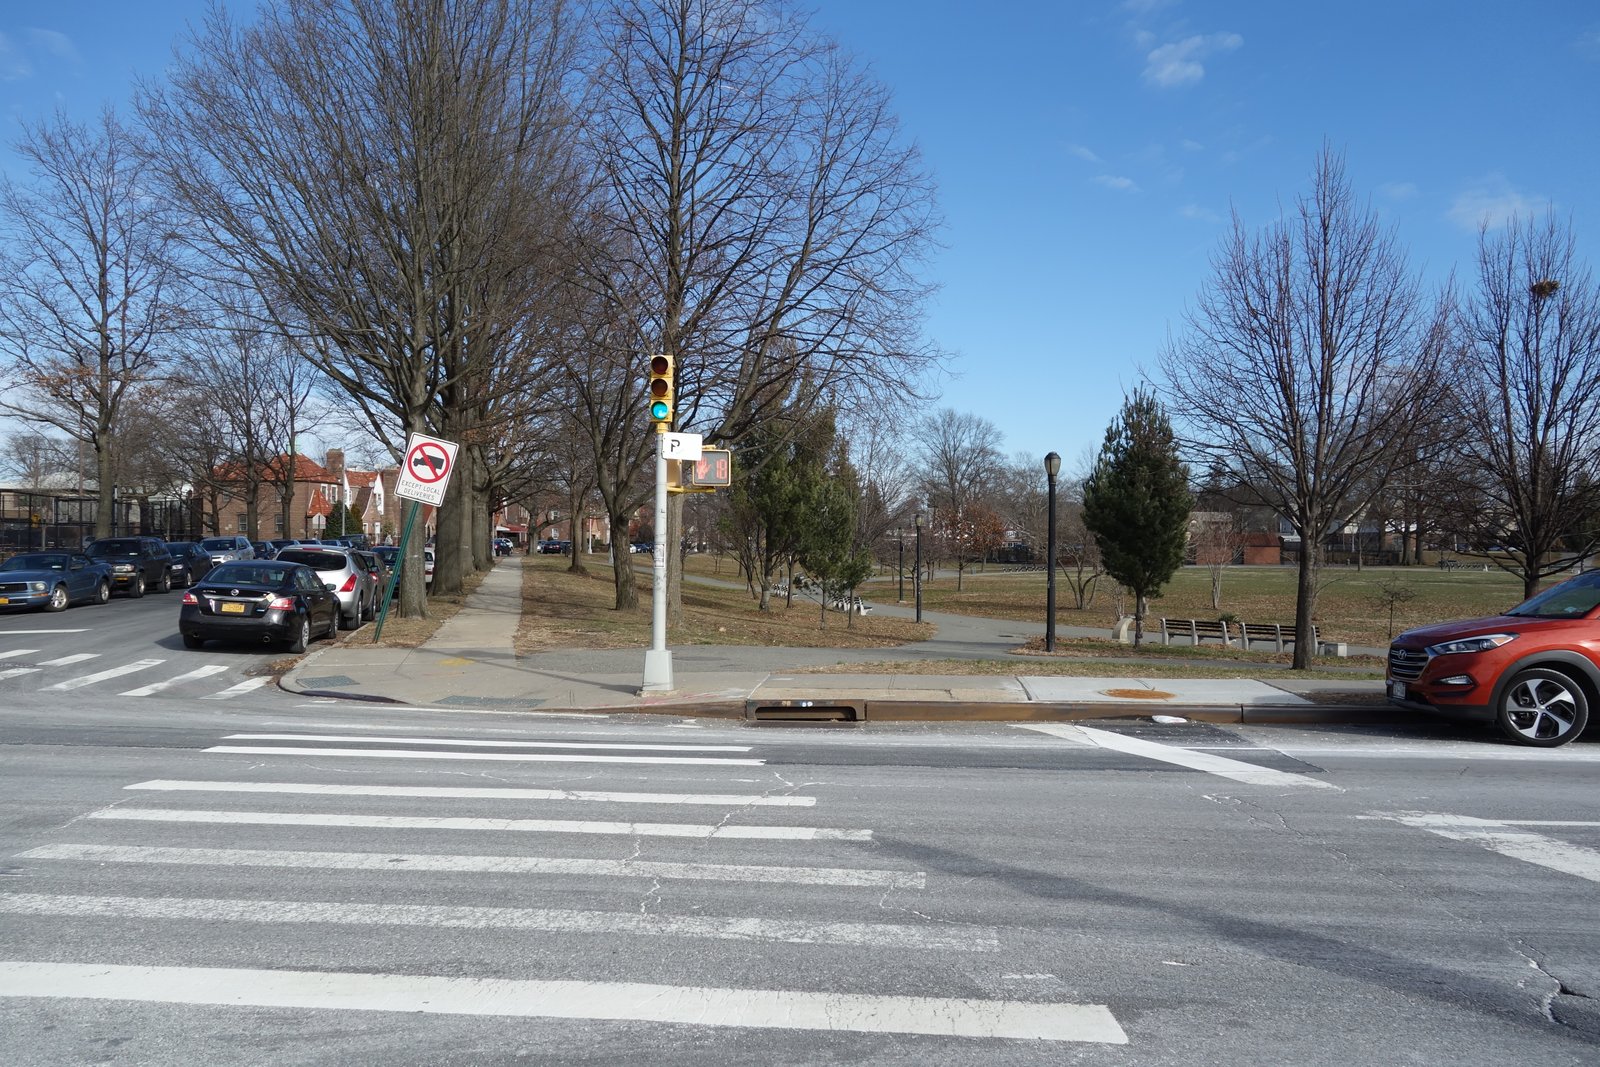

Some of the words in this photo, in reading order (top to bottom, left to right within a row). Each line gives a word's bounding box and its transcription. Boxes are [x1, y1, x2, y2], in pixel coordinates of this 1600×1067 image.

[716, 459, 728, 479] 18
[401, 480, 422, 490] EXCEPT
[423, 486, 440, 495] LOCAL
[403, 487, 435, 500] DELIVERIES
